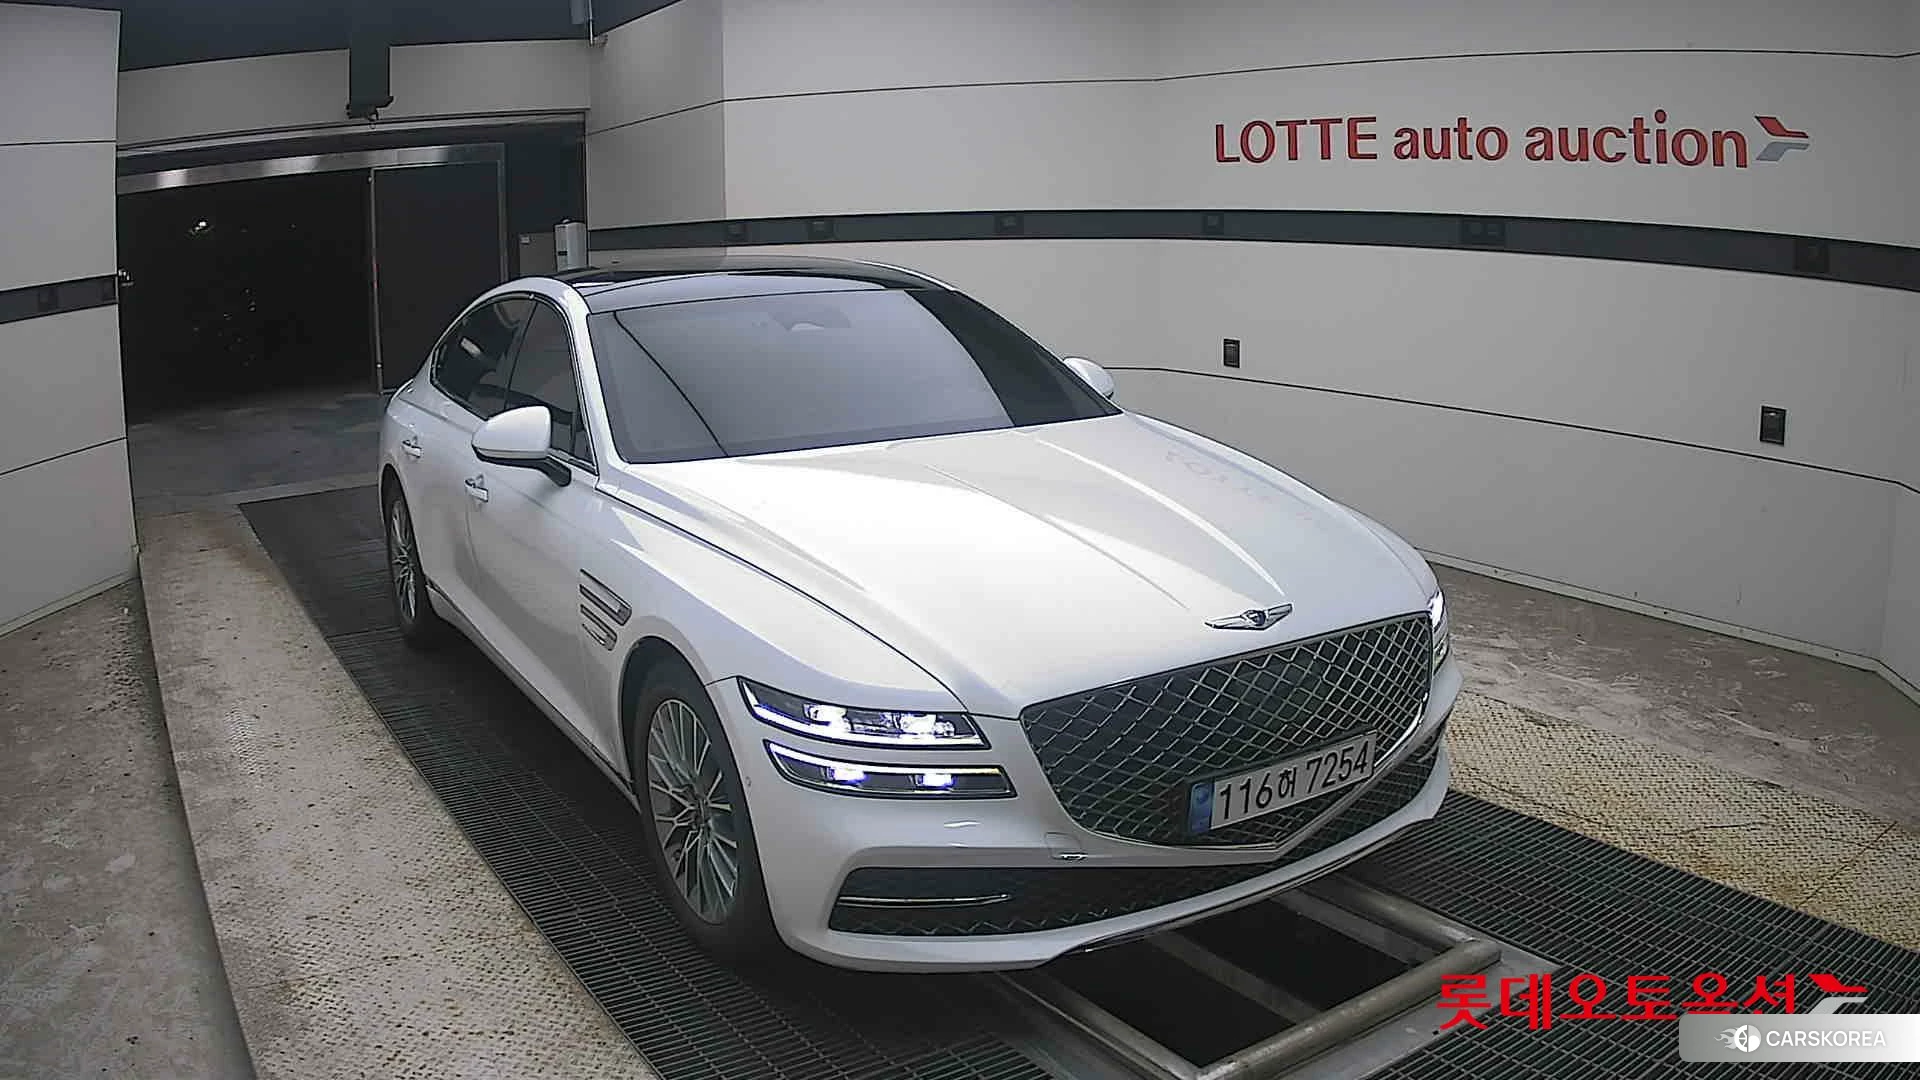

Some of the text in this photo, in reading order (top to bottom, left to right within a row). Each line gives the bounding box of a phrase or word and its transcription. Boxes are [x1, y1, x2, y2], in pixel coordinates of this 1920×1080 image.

[1216, 109, 1747, 168] LOTTE auto auction
[1220, 740, 1369, 819] 116허 7254
